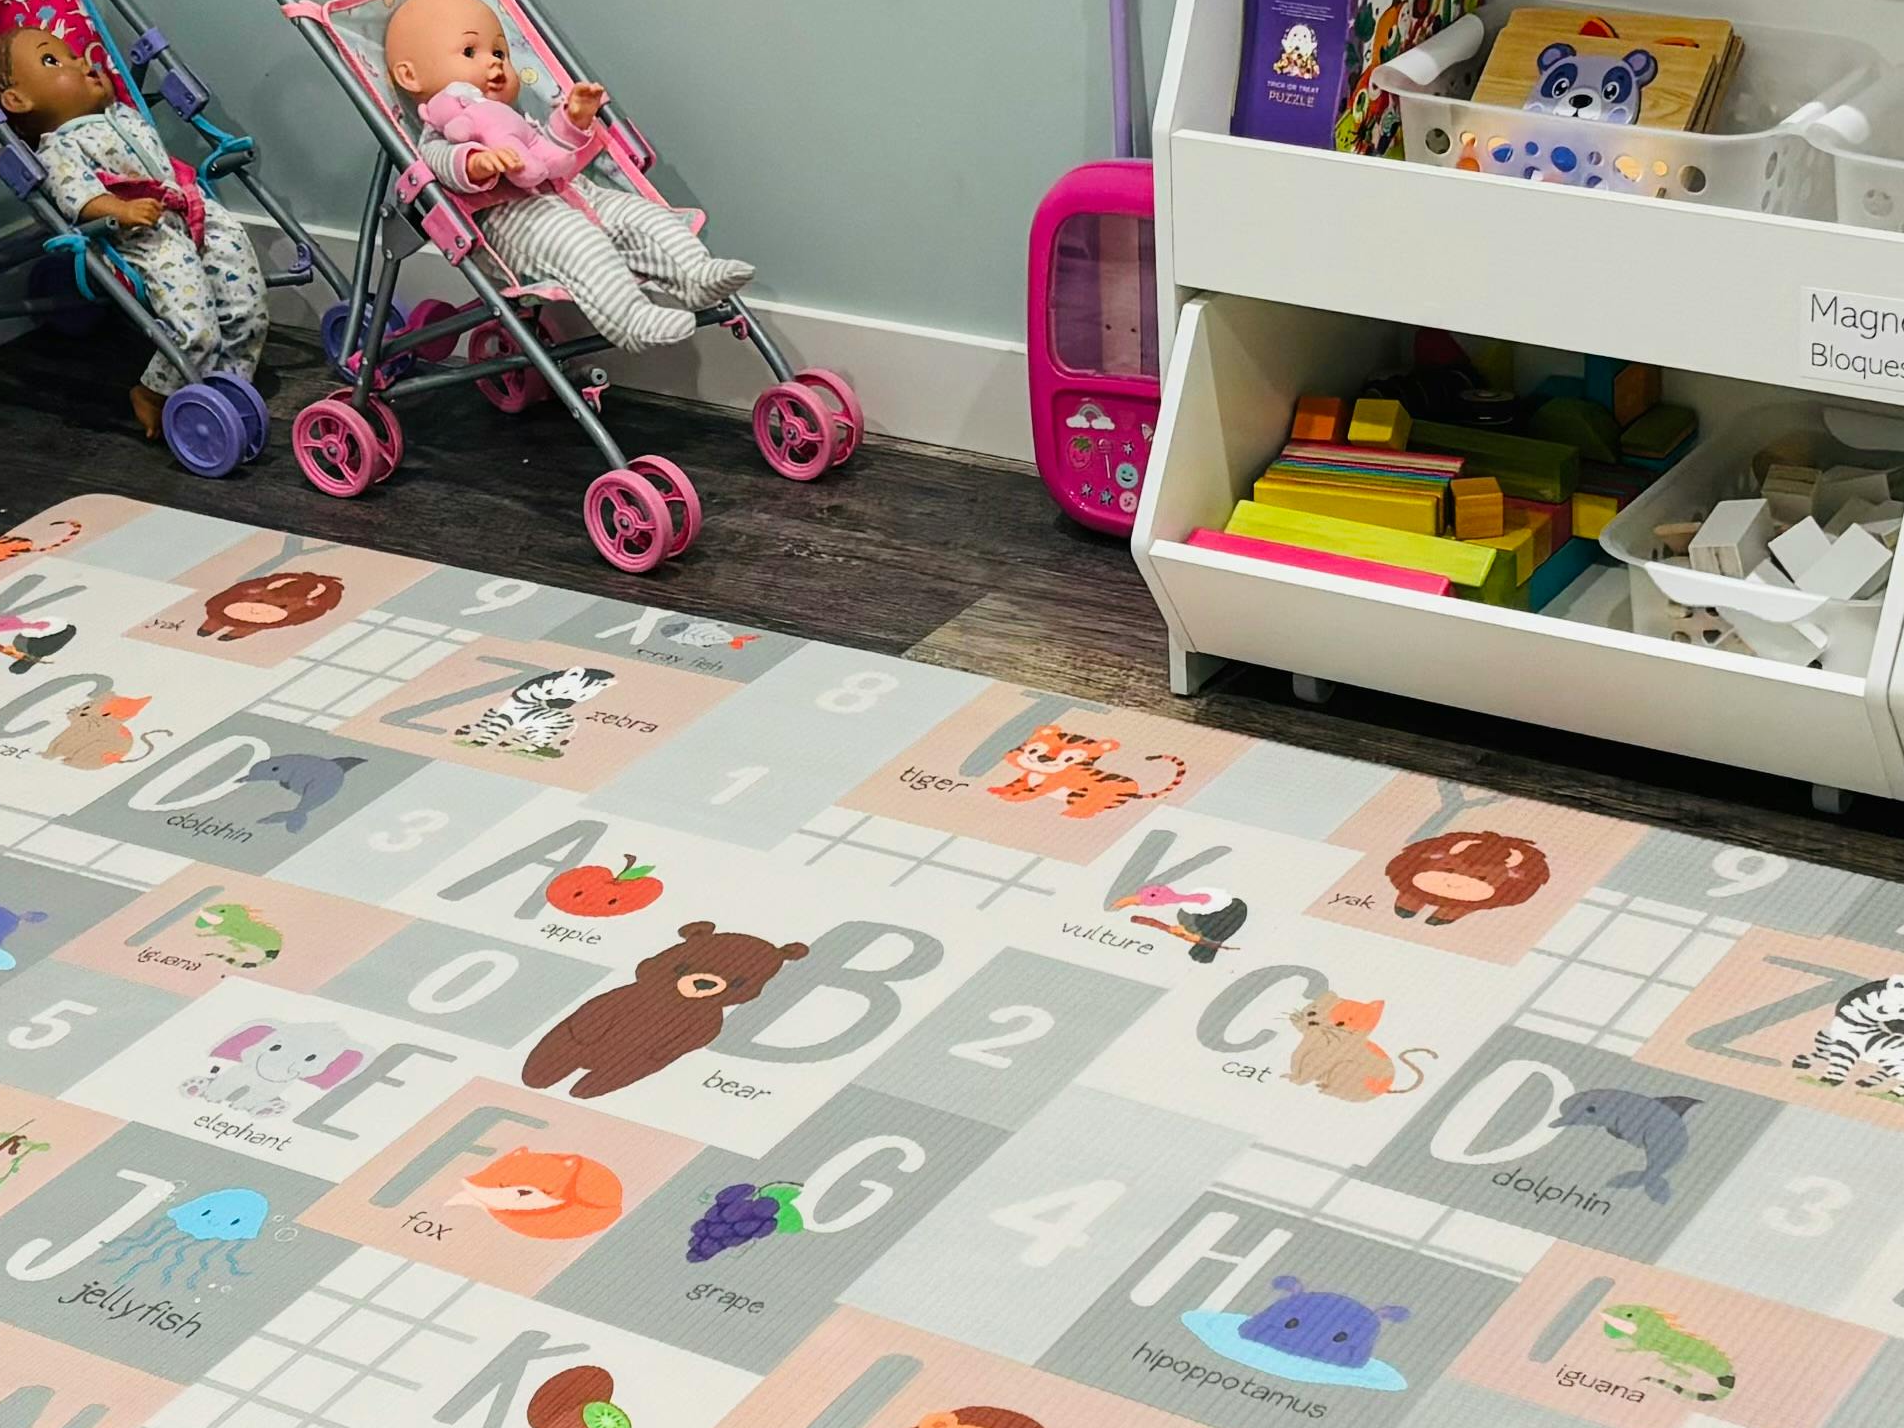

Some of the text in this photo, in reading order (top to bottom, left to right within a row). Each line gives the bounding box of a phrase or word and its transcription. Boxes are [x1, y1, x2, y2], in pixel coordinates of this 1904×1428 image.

[1269, 90, 1315, 108] PUZZLE
[461, 576, 540, 618] 9
[815, 670, 900, 715] 8
[128, 734, 271, 813] D
[711, 763, 771, 805] 1
[899, 763, 972, 798] tiger
[166, 811, 256, 845] dolphin
[368, 809, 451, 853] 3
[436, 818, 609, 921] A
[1104, 828, 1233, 913] V
[1705, 846, 1790, 899] 9
[539, 922, 604, 948] apple
[1060, 919, 1156, 956] vulture
[704, 919, 945, 1065] B
[1196, 963, 1330, 1056] C
[7, 999, 99, 1050] 5
[948, 1003, 1057, 1069] 2
[293, 1043, 459, 1141] E
[700, 1068, 773, 1103] bear
[1220, 1056, 1273, 1085] cat
[192, 1110, 294, 1153] elephant
[1428, 1058, 1578, 1166] D
[368, 1105, 550, 1208] F
[798, 1134, 927, 1236] G
[1491, 1165, 1613, 1220] dolphin
[1761, 1175, 1853, 1240] 3
[5, 1167, 177, 1283] J
[400, 1208, 454, 1244] fox
[989, 1177, 1128, 1268] 4
[1128, 1208, 1294, 1315] H
[57, 1279, 206, 1341] jellyfish
[684, 1278, 767, 1317] grape
[1554, 1362, 1646, 1407] iguana
